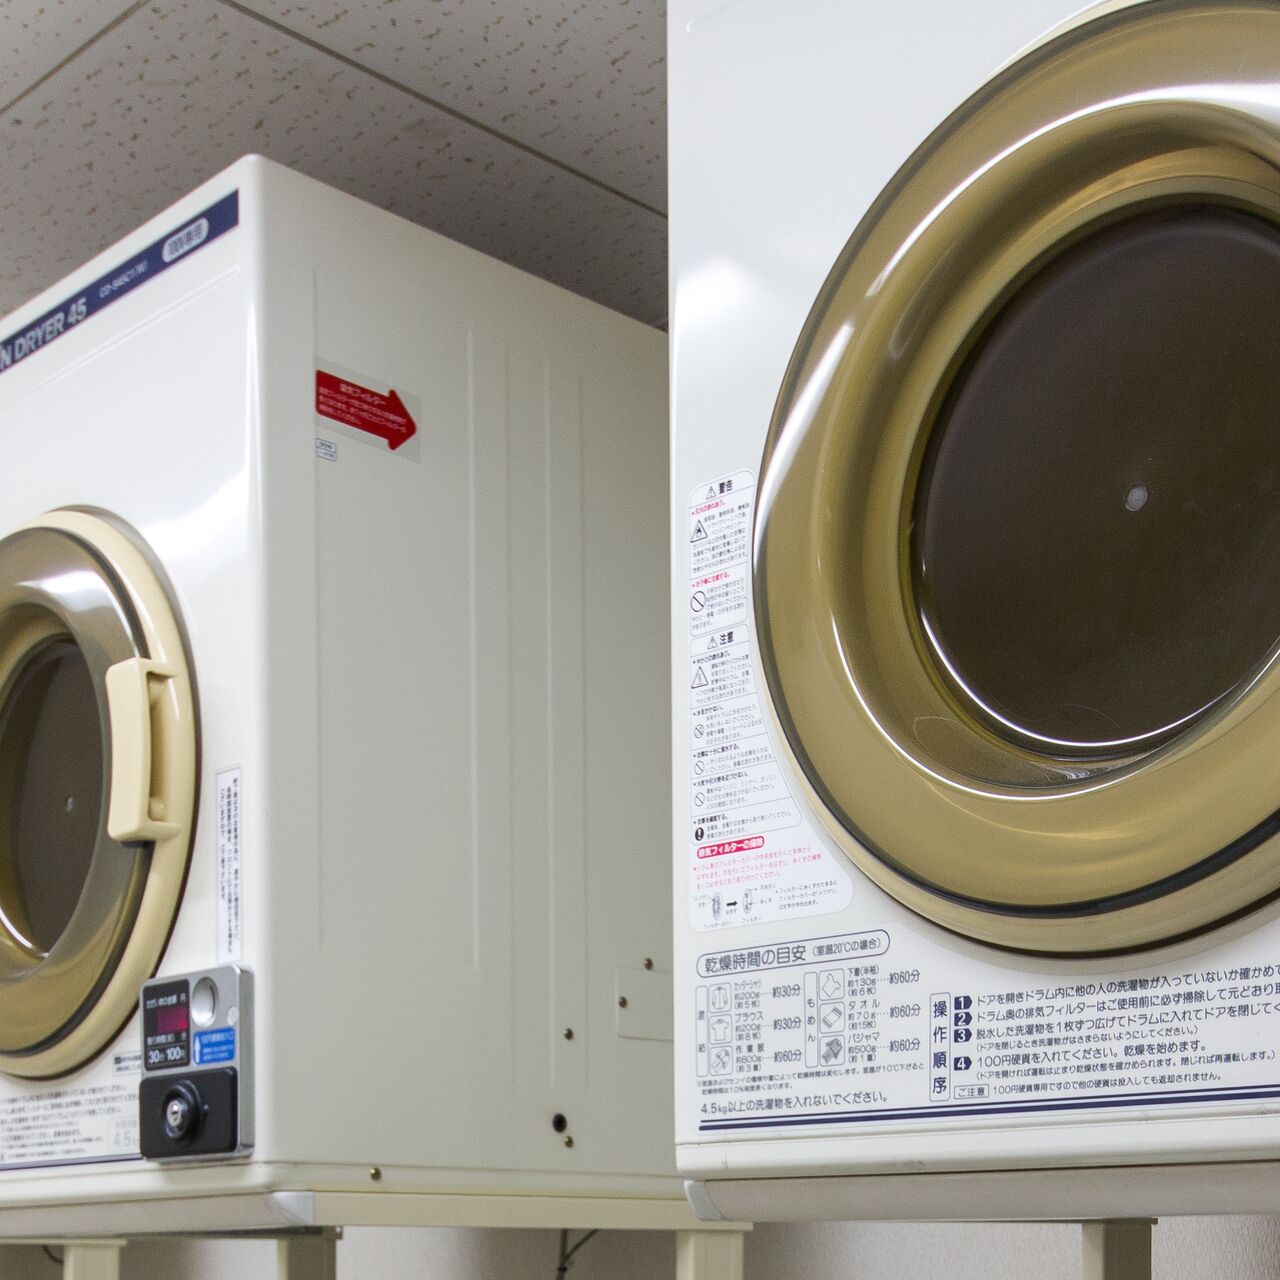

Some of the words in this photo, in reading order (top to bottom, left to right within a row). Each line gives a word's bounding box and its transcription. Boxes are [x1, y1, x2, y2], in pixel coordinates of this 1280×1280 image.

[14, 312, 64, 363] DRYER
[67, 297, 87, 325] 45
[704, 945, 806, 973] 乾燥時間の目安
[889, 970, 920, 984] 約60分
[772, 984, 801, 998] 約30分
[848, 999, 880, 1010] タオル
[889, 1004, 920, 1018] 約60分
[773, 1017, 801, 1030] 約30分
[806, 998, 816, 1042] もめん
[848, 1032, 880, 1044] パジャマ
[889, 1038, 920, 1052] 約60分
[932, 1000, 948, 1094] 操作順序
[977, 1039, 1207, 1068] 100円硬貨を入れてください。乾燥を始めます。
[773, 1049, 802, 1063] 約60分
[958, 1087, 986, 1098] ご注意
[993, 1072, 1222, 1095] 100円硬貨専用ですので他の硬貨は投入しても返却されません。
[701, 1091, 888, 1114] 4.5kg以上の洗濯物を入れないでください。
